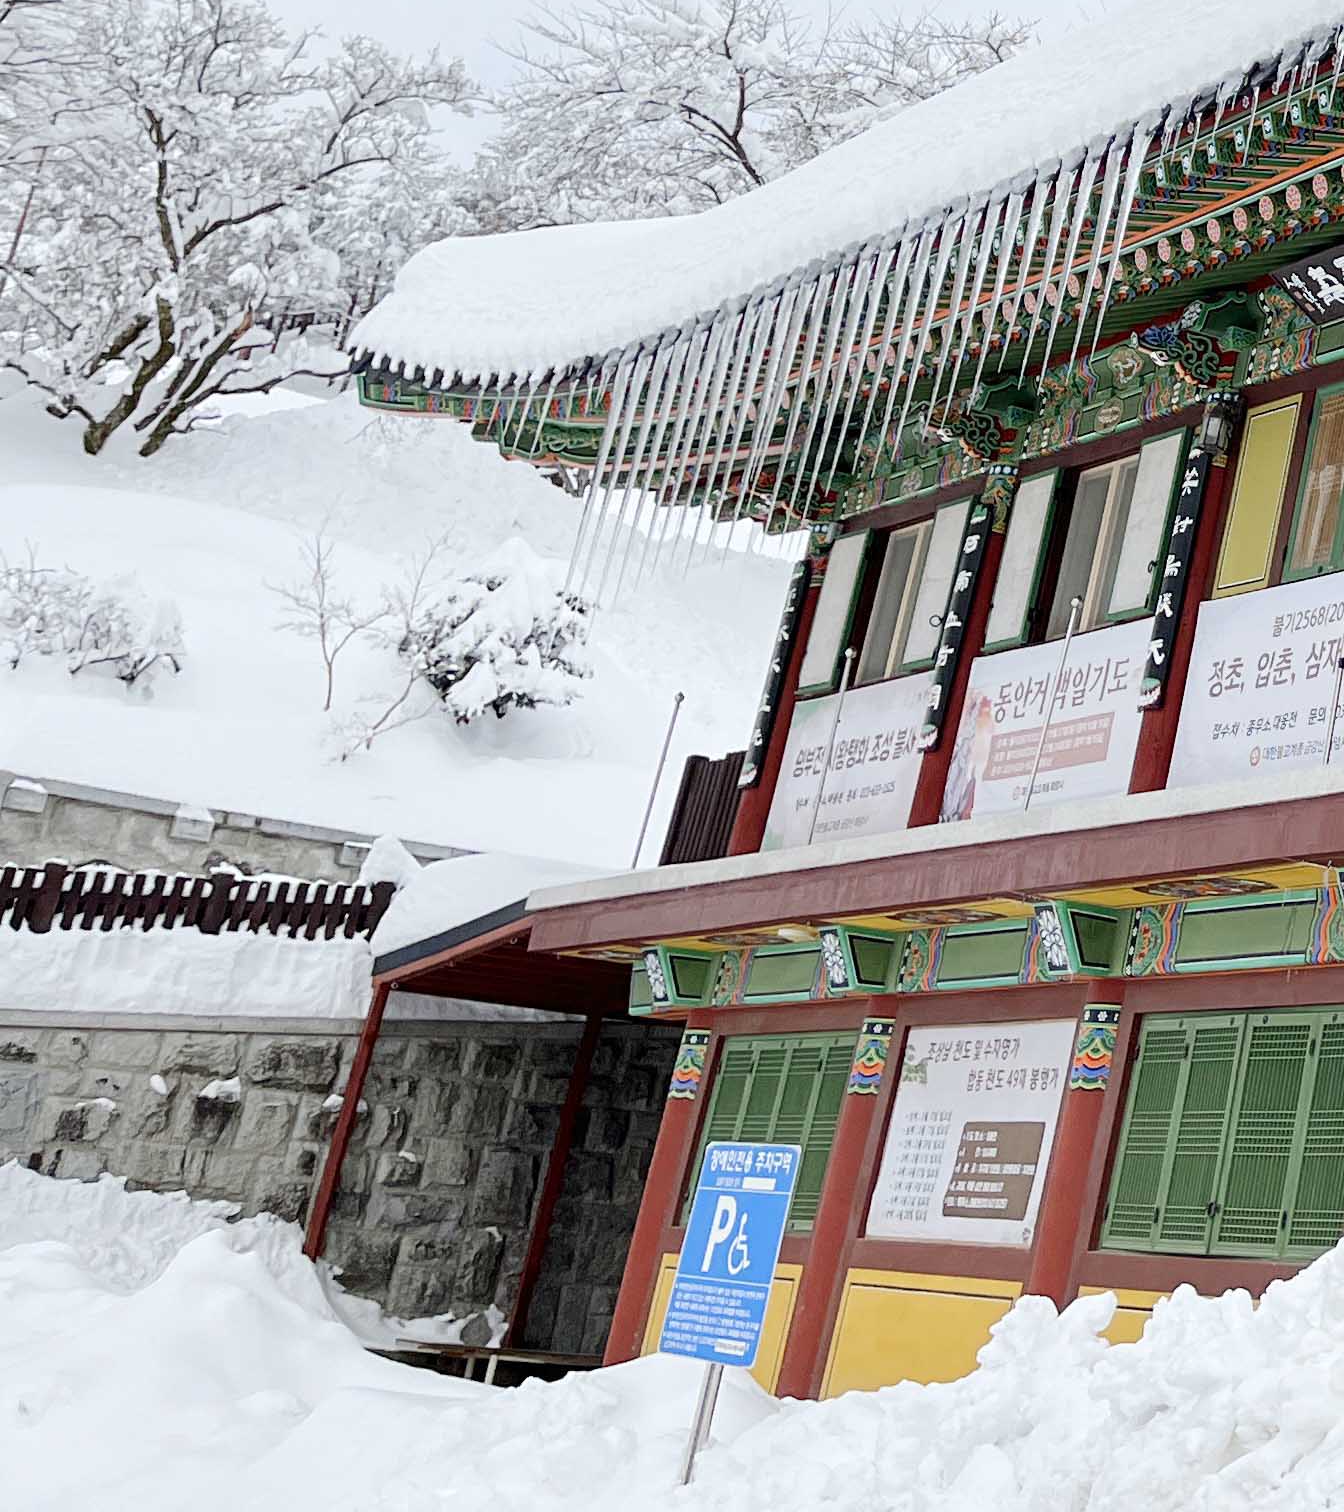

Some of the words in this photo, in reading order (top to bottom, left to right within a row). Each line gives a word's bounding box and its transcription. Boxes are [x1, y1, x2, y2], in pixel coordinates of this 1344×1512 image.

[1208, 656, 1244, 697] 정초,
[1255, 648, 1296, 689] 입춘,
[701, 1195, 736, 1272] P
